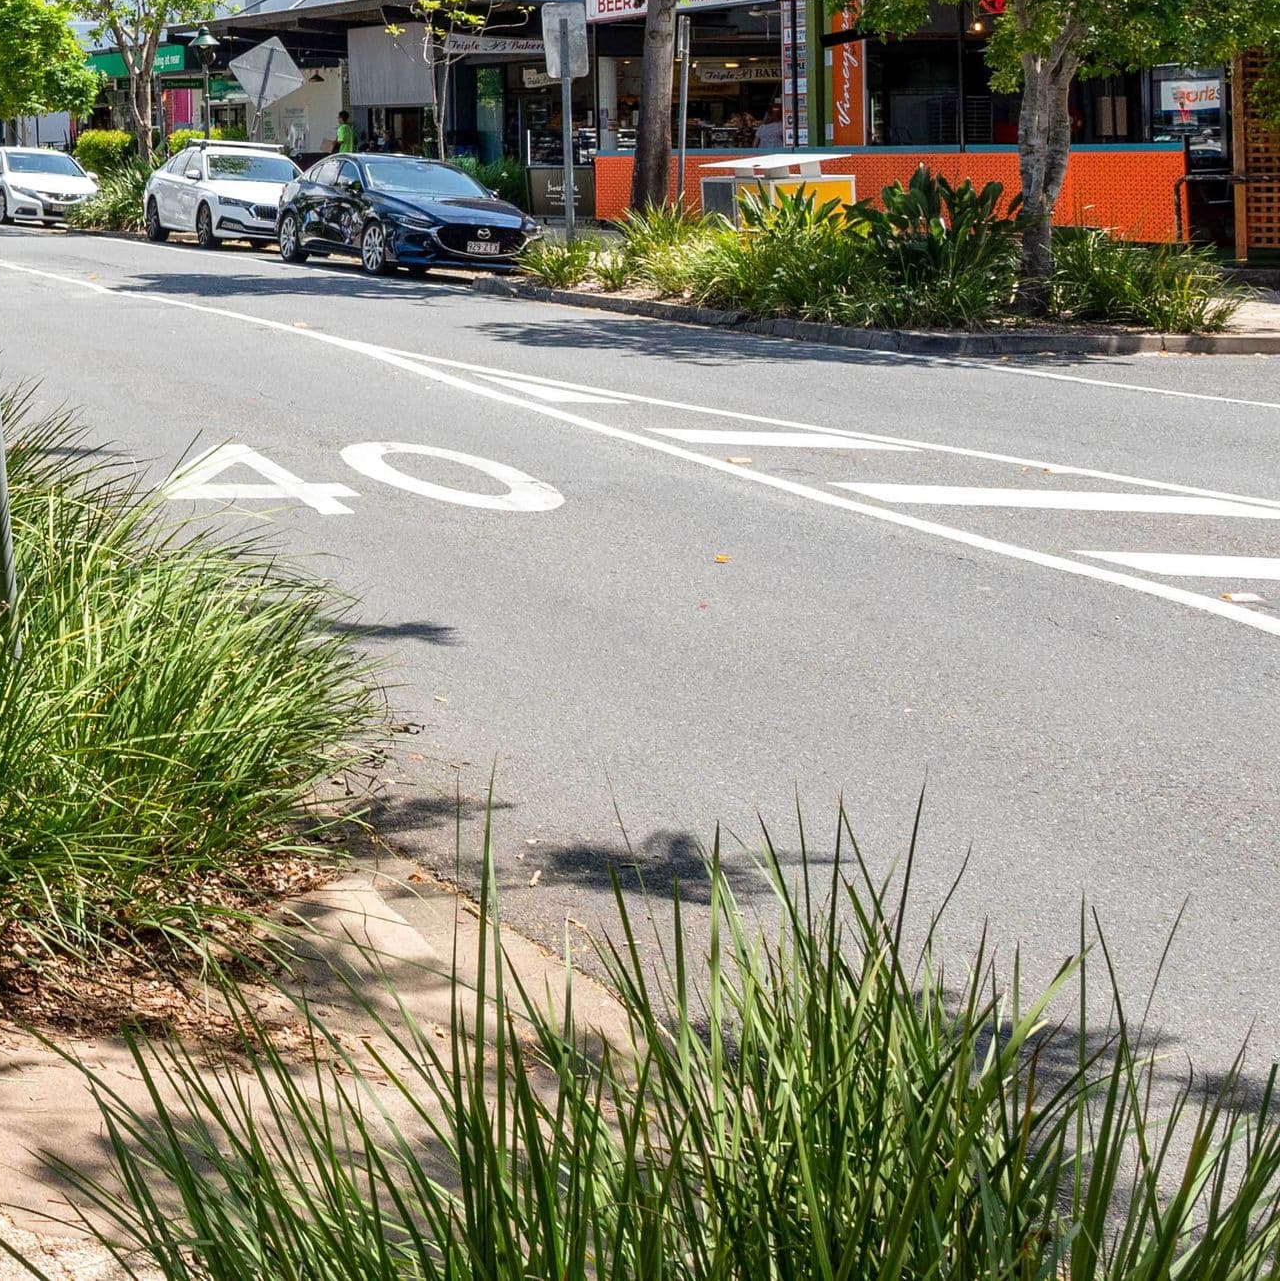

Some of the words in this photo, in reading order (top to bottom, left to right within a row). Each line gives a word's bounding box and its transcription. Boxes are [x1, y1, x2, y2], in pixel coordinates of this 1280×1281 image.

[448, 40, 480, 51] Triple
[755, 68, 782, 78] BAK
[162, 441, 565, 516] 40
